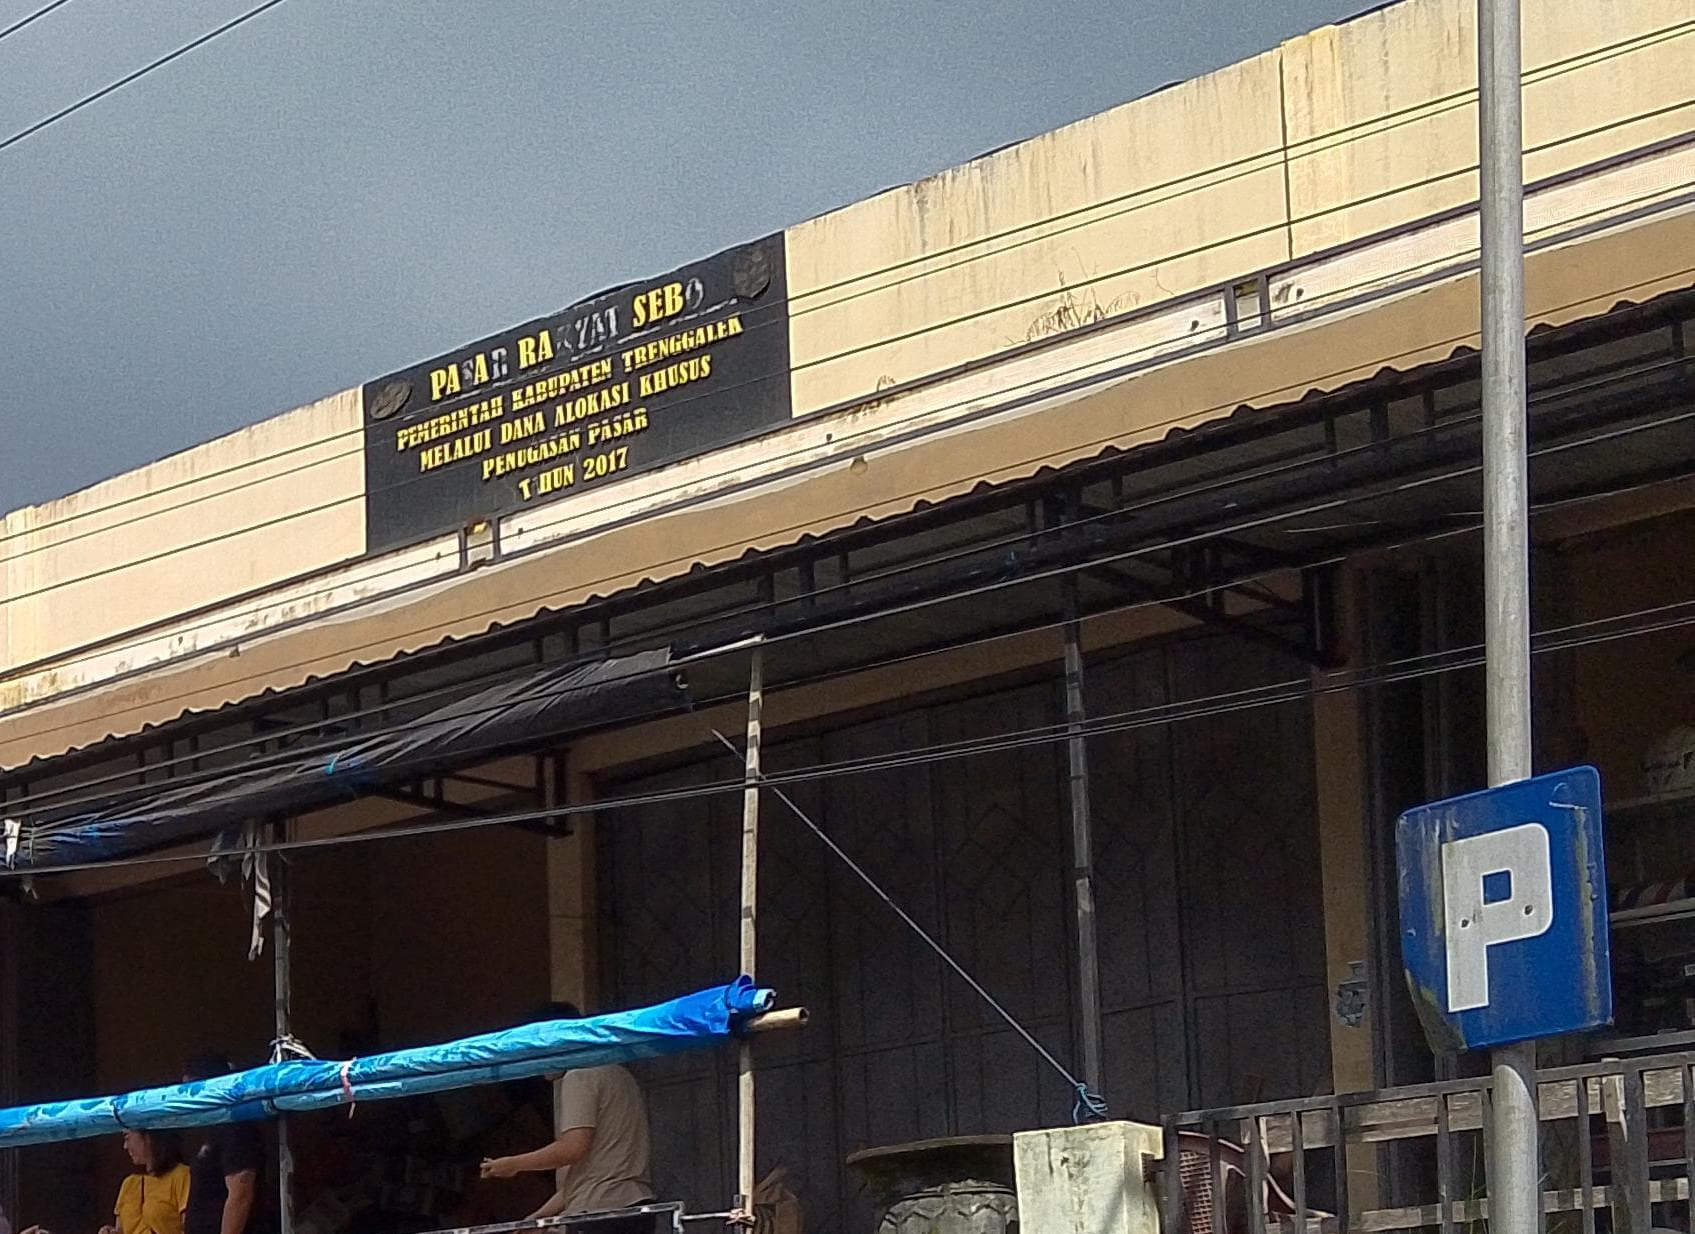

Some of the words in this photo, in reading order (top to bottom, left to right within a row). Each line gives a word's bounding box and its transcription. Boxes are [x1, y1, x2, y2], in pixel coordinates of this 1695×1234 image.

[396, 396, 504, 451] PEMERINTAH
[512, 358, 612, 411] KABUPATEN
[419, 428, 493, 473] MELALUI
[500, 410, 546, 445] DANA
[554, 382, 630, 427] ALOKASI
[639, 354, 712, 398] KHUSUS
[482, 428, 581, 480] PENUGASAN
[587, 407, 649, 445] PASAR
[518, 463, 575, 501] THUN
[583, 446, 629, 480] 2017
[1441, 821, 1554, 1013] P
